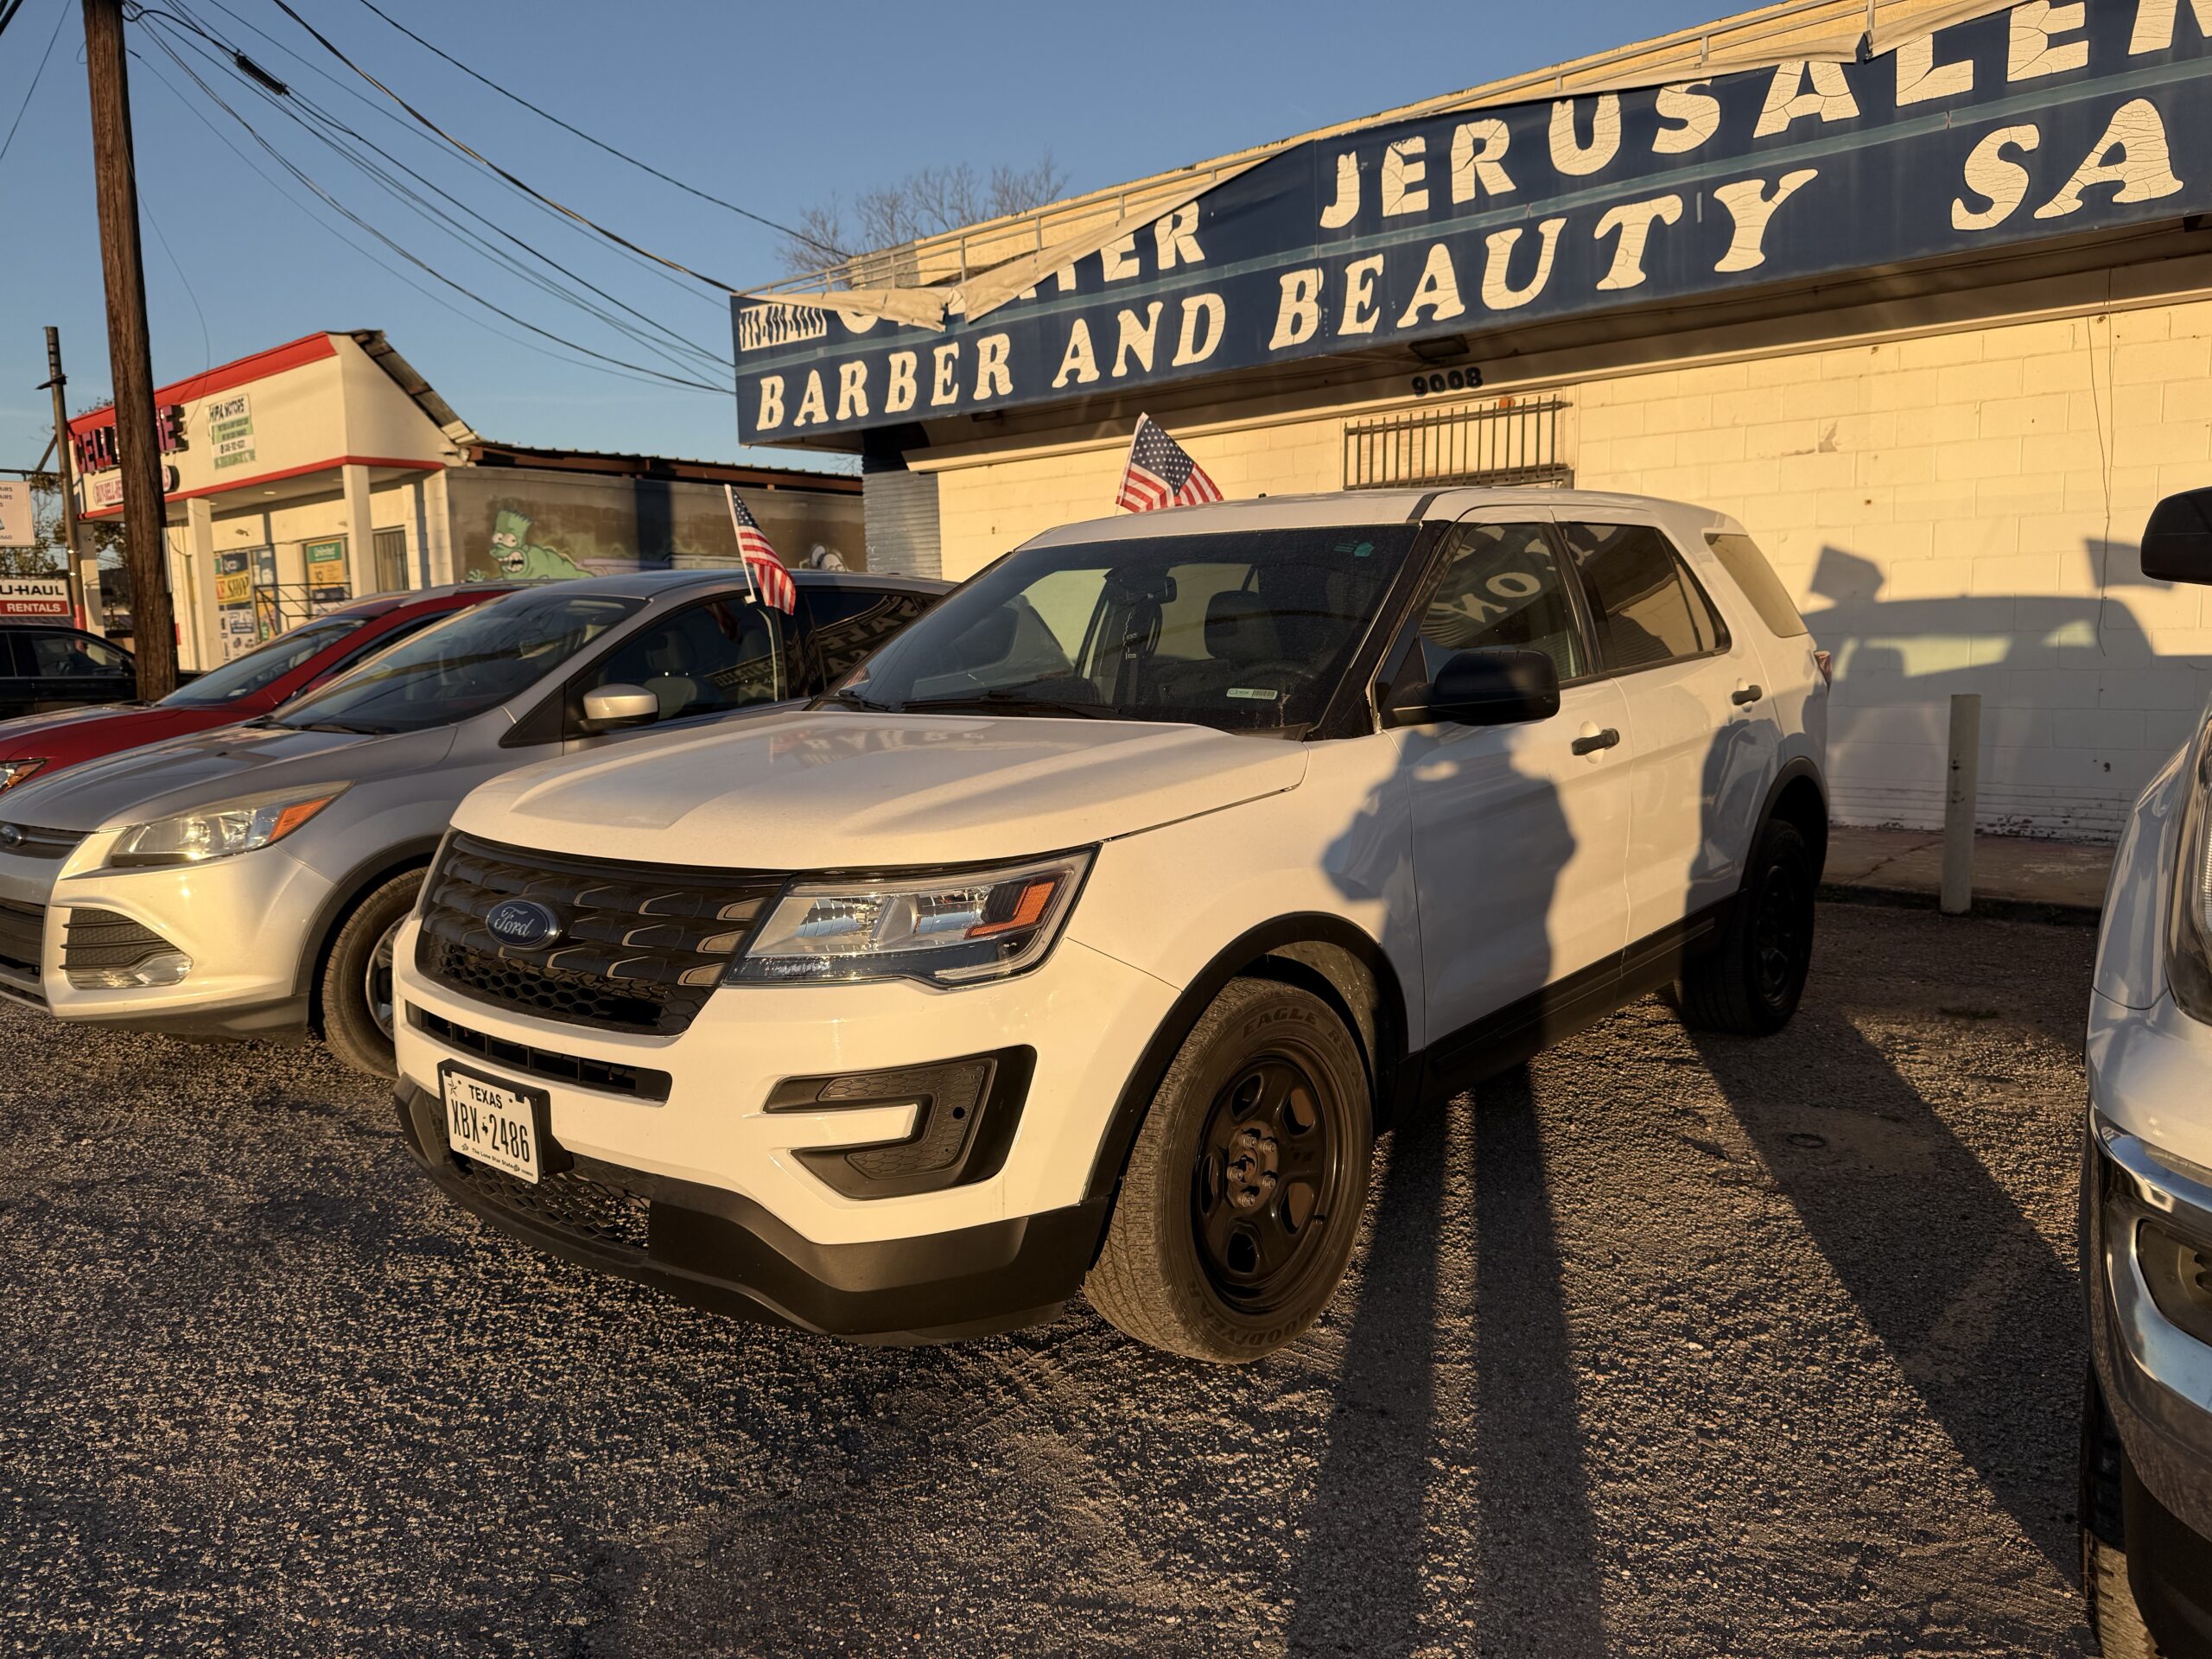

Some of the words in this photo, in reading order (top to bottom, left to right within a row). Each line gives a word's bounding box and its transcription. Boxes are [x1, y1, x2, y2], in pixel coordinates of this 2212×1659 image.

[757, 333, 1014, 431] BARBER
[1052, 292, 1226, 388] AND
[1268, 168, 1818, 351] BEAUTY
[1411, 366, 1484, 397] 9008
[7, 603, 61, 613] RENTALS
[493, 906, 531, 938] Ford
[1243, 1007, 1319, 1039] EAGLE
[467, 1084, 503, 1109] TEXAS
[471, 1147, 480, 1156] The
[480, 1150, 492, 1160] Lone
[492, 1155, 501, 1164] Star
[501, 1159, 514, 1169] State
